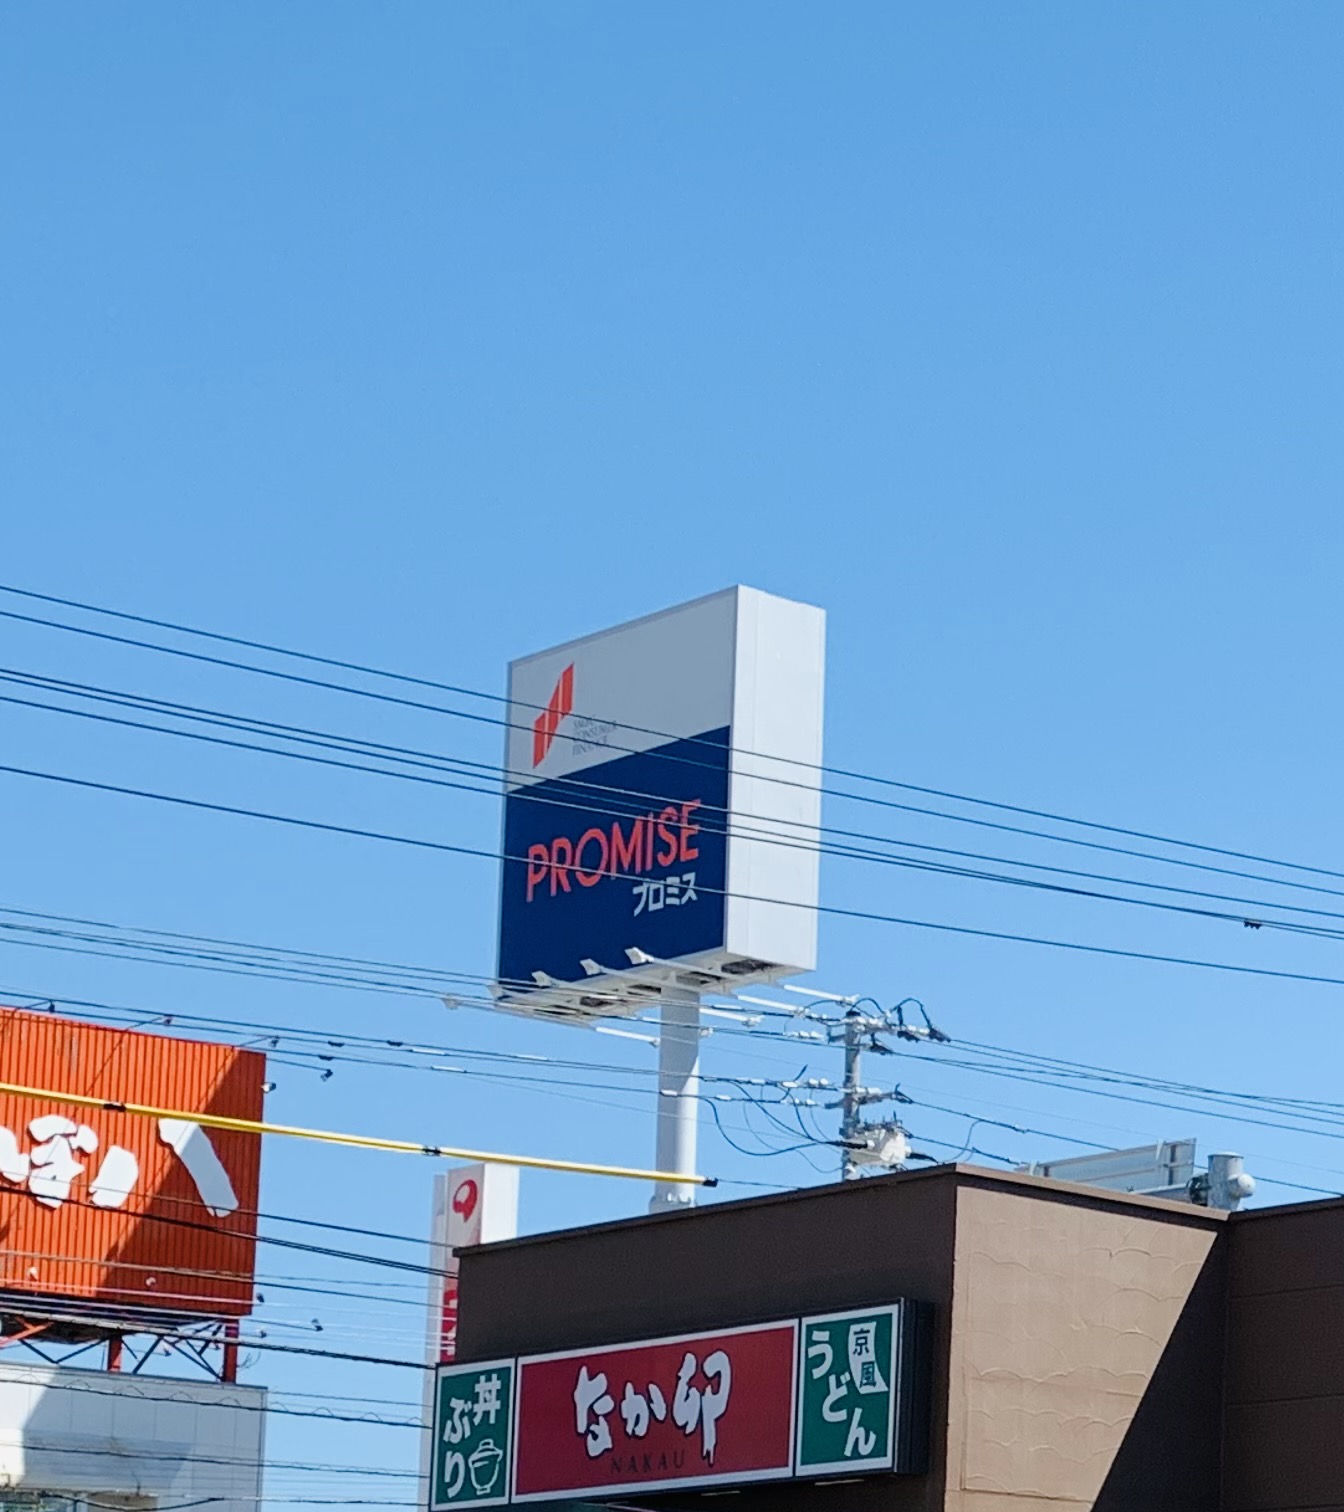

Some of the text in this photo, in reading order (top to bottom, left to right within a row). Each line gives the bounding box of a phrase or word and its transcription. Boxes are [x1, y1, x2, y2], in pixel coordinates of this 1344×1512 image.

[526, 799, 701, 902] PROMISE
[633, 871, 698, 917] プロミス
[573, 1349, 732, 1465] なか卯
[610, 1449, 686, 1474] NAKAU
